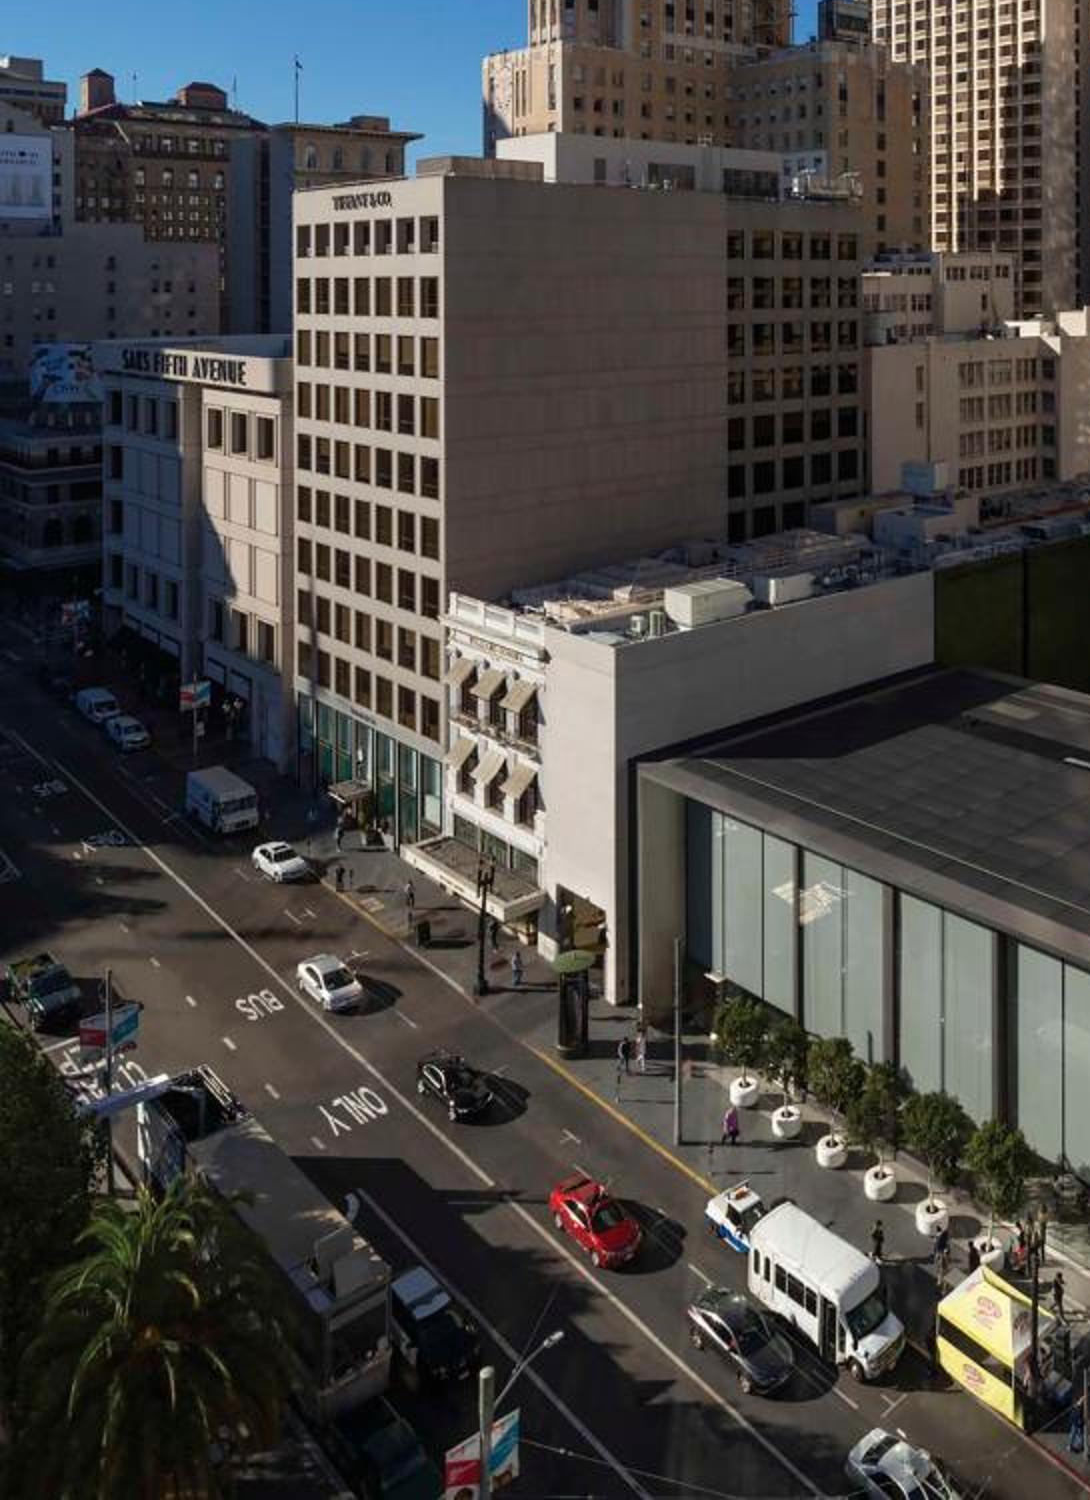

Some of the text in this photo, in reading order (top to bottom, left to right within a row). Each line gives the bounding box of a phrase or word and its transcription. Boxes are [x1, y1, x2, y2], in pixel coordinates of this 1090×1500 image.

[122, 347, 247, 386] SAKS FIFTH AVENUE
[235, 989, 285, 1021] BUS
[318, 1086, 389, 1137] ONLY
